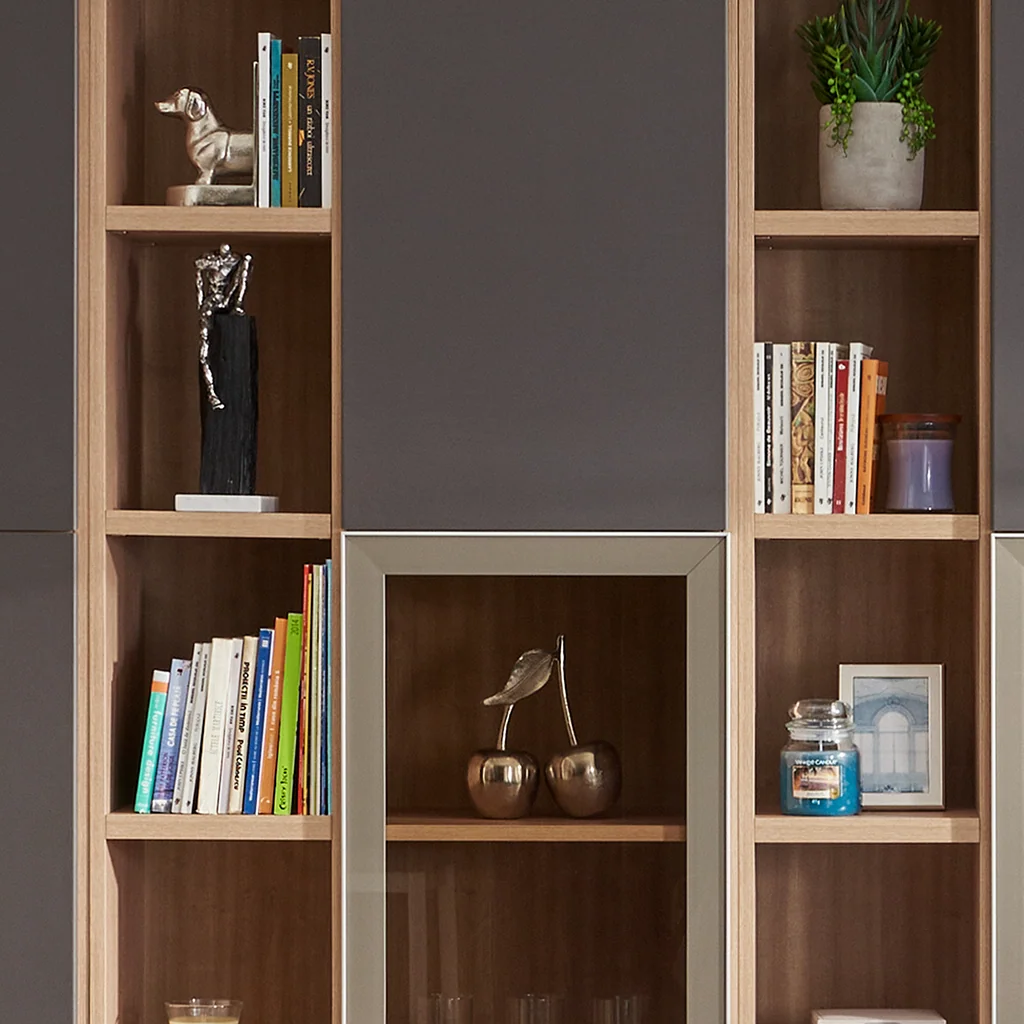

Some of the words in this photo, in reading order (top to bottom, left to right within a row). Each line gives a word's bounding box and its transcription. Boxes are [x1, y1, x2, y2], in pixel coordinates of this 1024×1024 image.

[149, 710, 161, 756] furniture
[167, 727, 177, 747] CASA
[142, 759, 154, 795] design
